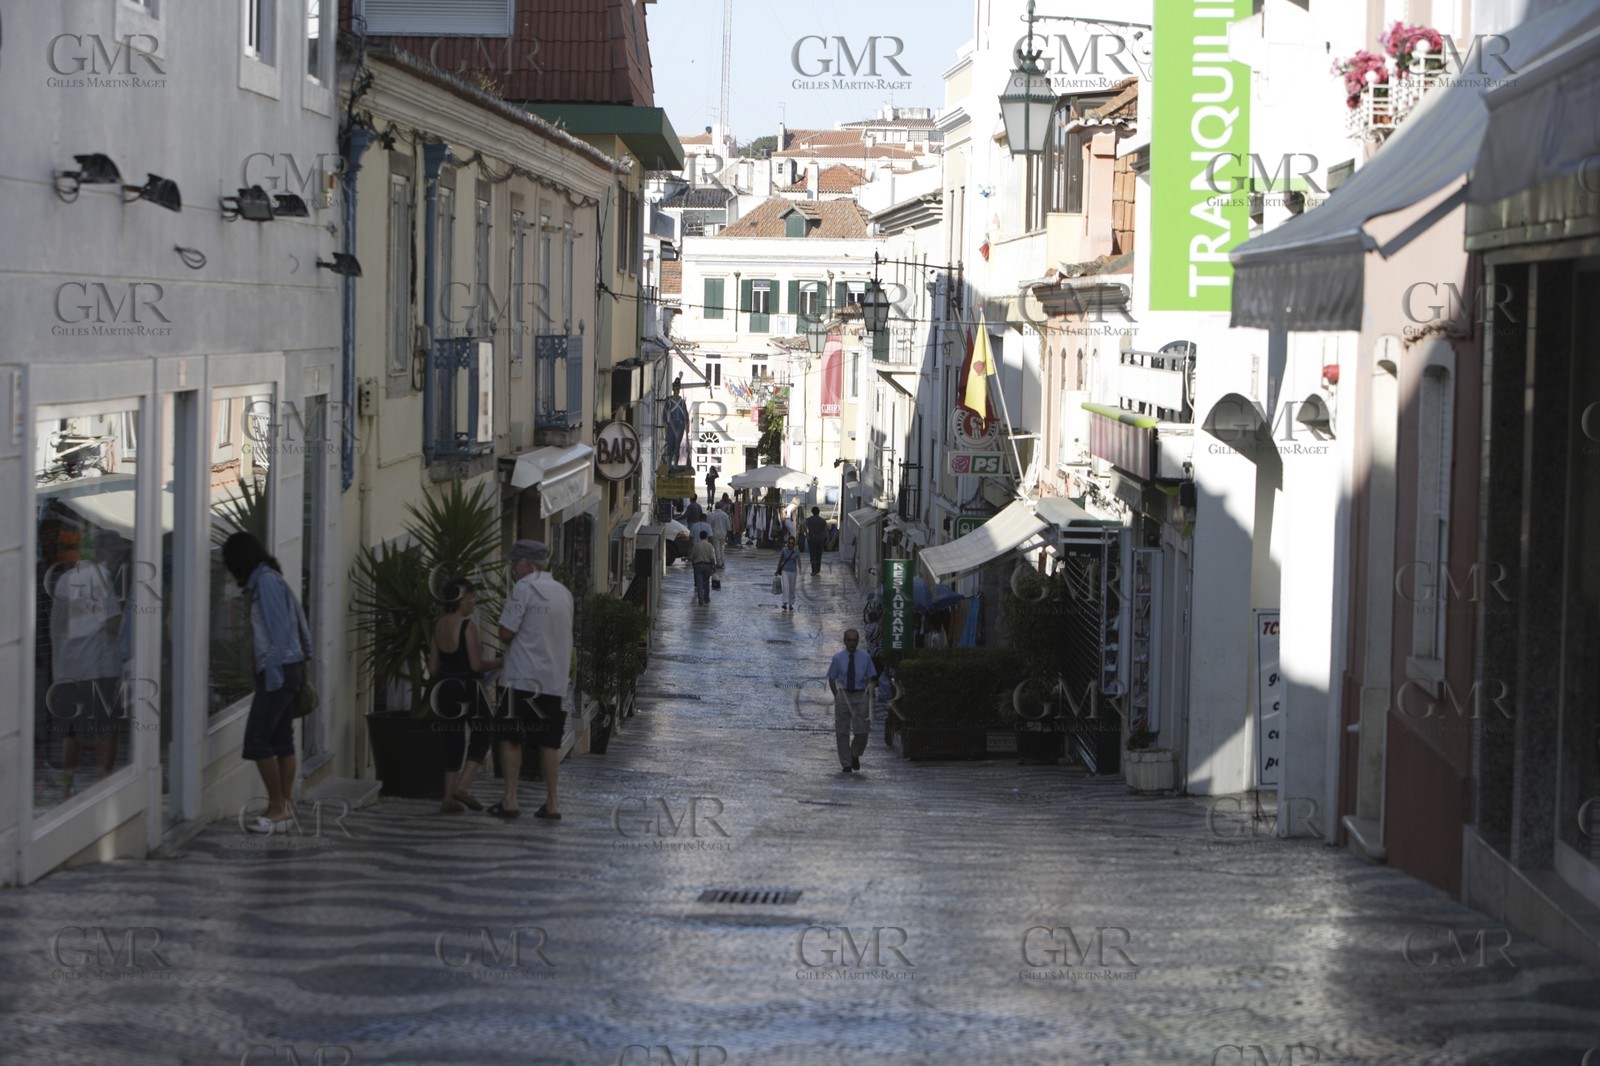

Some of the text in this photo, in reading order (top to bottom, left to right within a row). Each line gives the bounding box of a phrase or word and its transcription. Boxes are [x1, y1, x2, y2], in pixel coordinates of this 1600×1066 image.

[1189, 0, 1240, 299] TRANQUILI
[597, 437, 636, 464] BAR
[974, 457, 998, 472] PS
[892, 562, 904, 649] RESTAURANTE
[1263, 621, 1280, 635] TC
